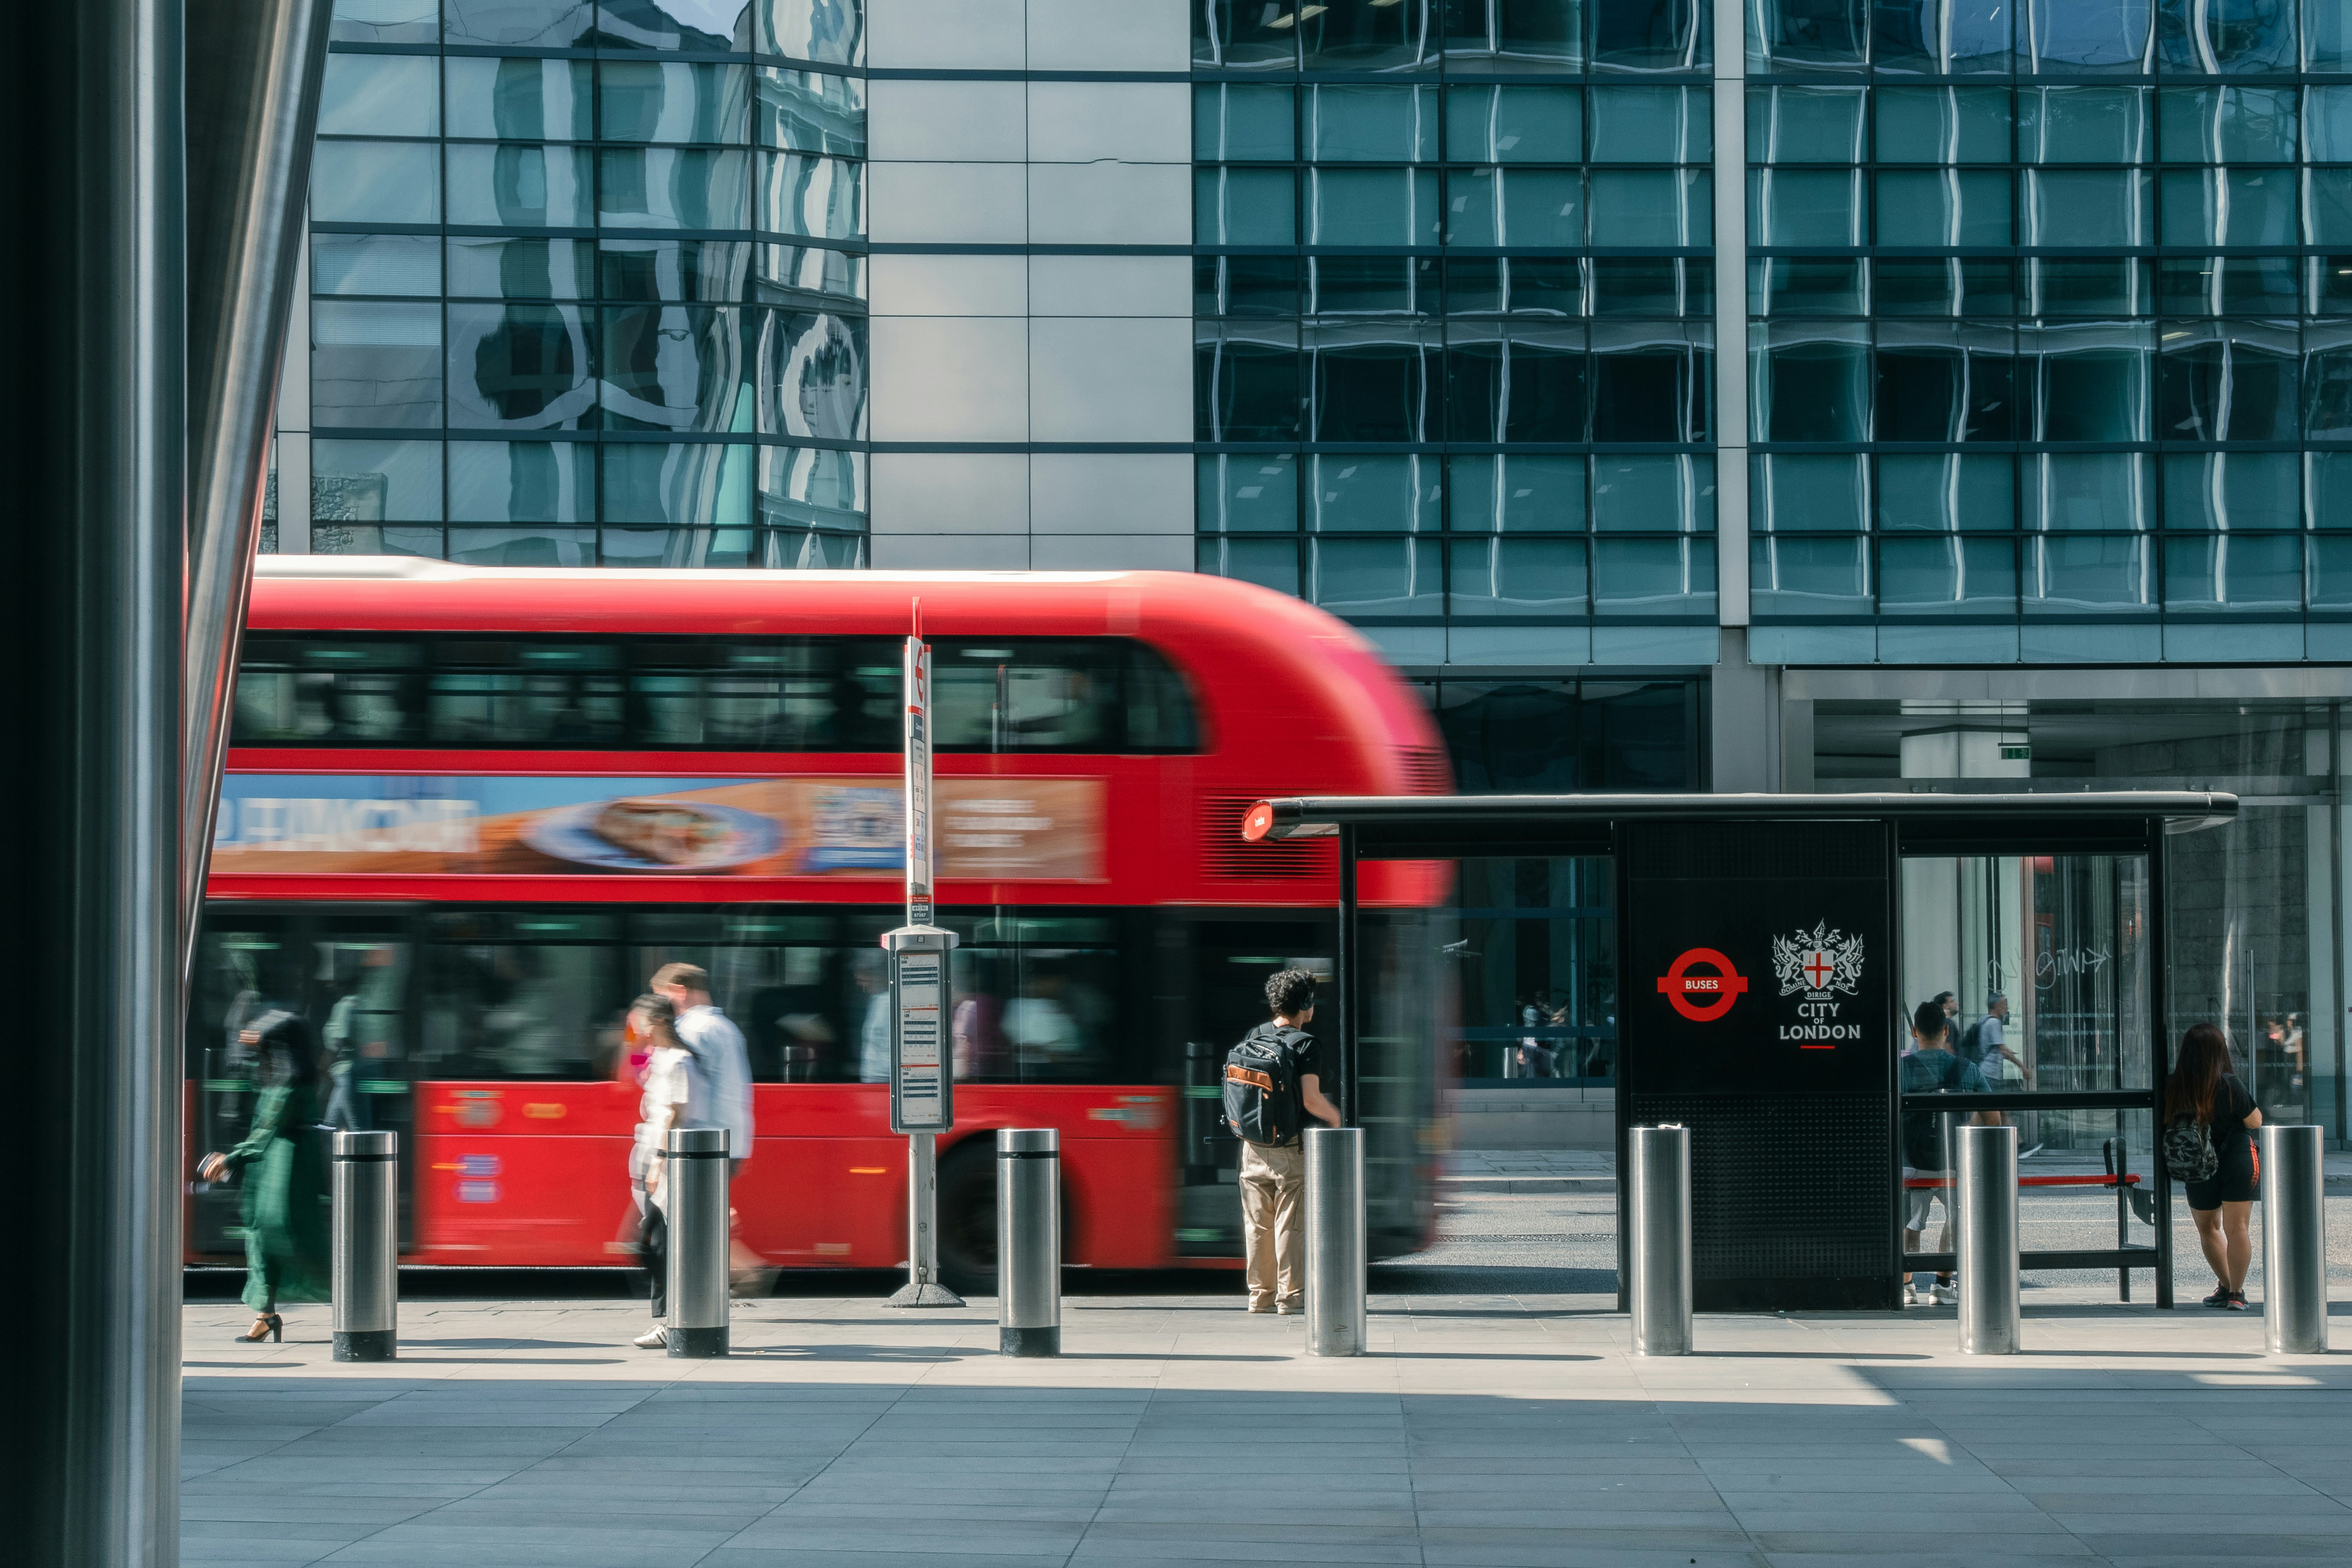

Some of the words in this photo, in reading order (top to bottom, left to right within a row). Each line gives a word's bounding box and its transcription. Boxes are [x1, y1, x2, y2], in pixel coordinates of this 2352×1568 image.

[1685, 980, 1718, 989] BUSES
[1781, 980, 1807, 994] DOMINE
[1835, 981, 1849, 991] NOS
[1798, 1003, 1840, 1017] CITY
[1780, 1025, 1860, 1039] LONDON
